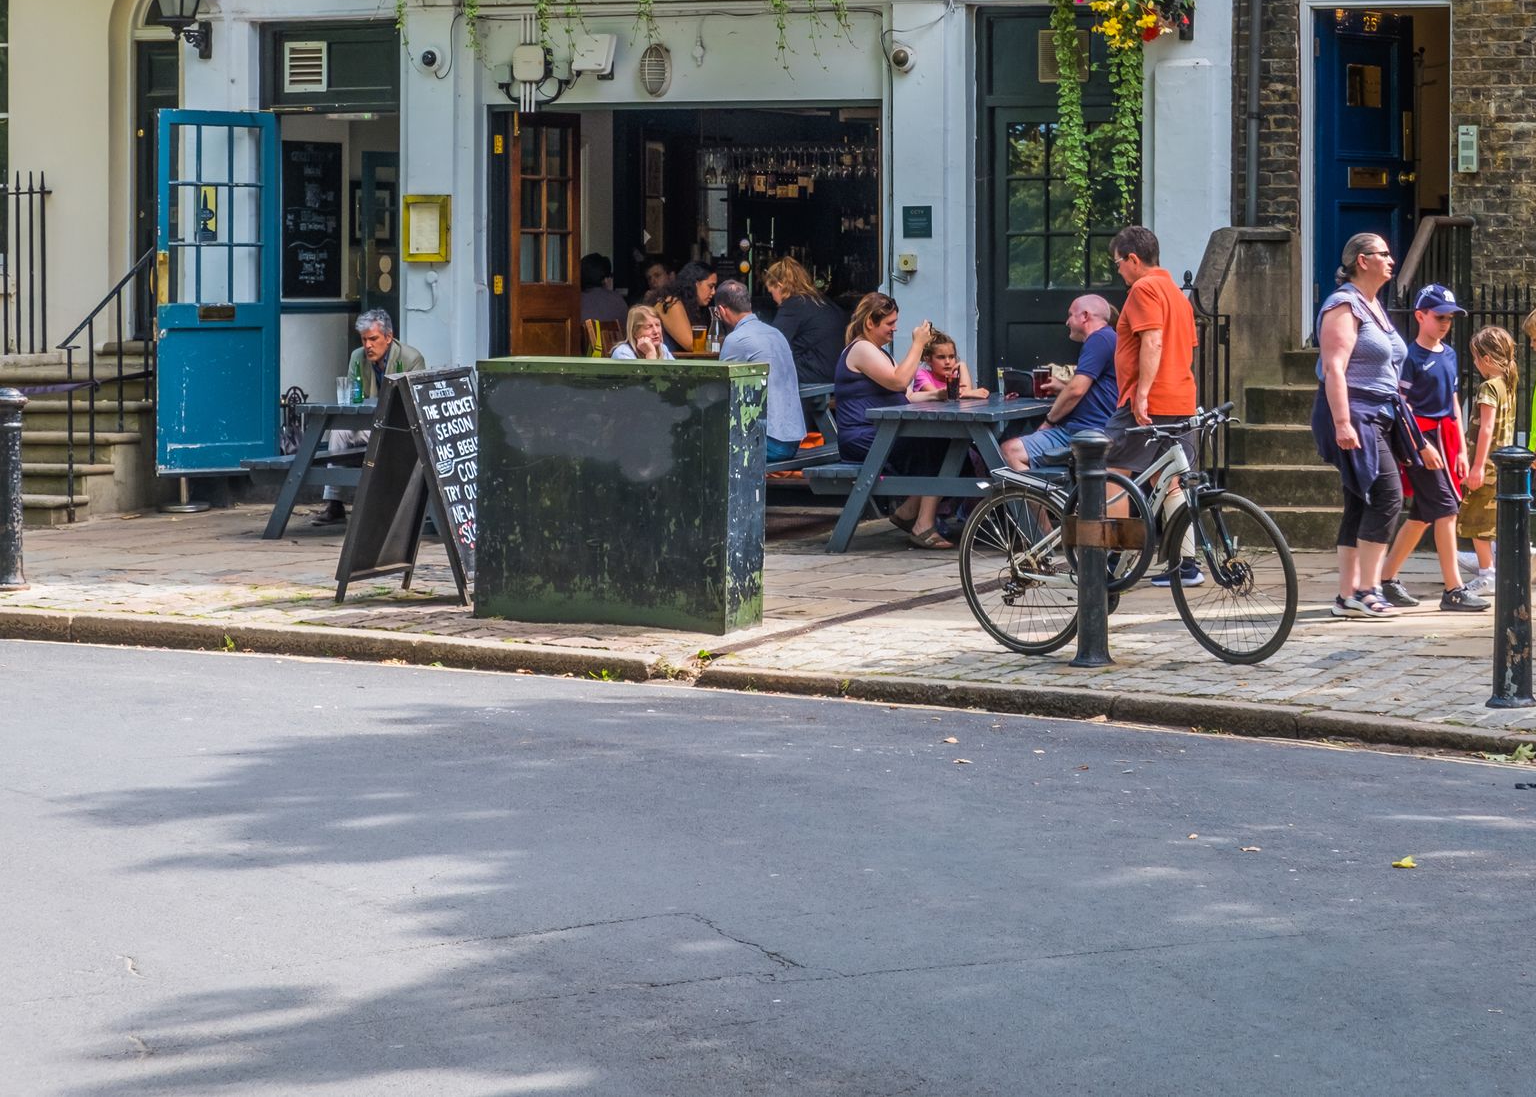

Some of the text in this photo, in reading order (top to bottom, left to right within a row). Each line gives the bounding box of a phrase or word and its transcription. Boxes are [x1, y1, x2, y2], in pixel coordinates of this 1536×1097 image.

[1363, 16, 1378, 31] 25
[423, 396, 475, 420] THE CRICKET
[436, 415, 474, 440] SEASON
[436, 436, 478, 461] HAS BEGU
[444, 485, 461, 503] TRY
[452, 504, 475, 524] NEW
